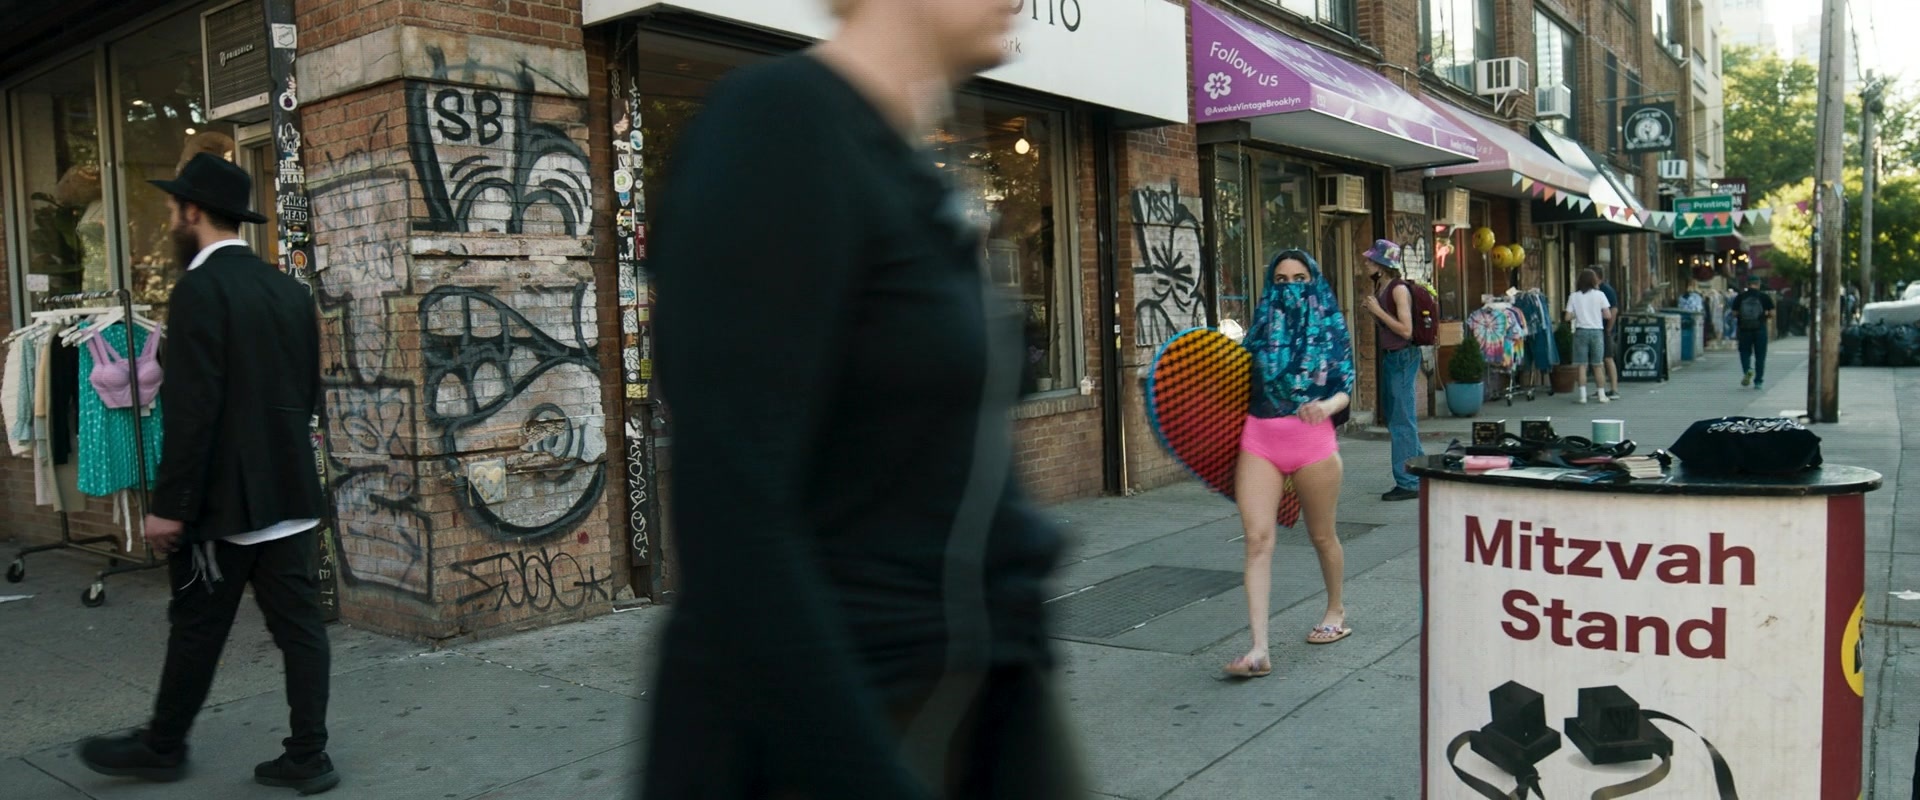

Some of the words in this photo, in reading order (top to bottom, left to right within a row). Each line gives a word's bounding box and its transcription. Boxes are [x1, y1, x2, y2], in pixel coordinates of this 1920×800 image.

[1002, 37, 1021, 53] ork
[1210, 41, 1257, 78] Follow
[1258, 73, 1278, 87] us
[1204, 97, 1301, 116] @AwokeVintageBrooklyn
[434, 88, 503, 145] SB
[283, 195, 308, 207] SNKR
[1693, 200, 1730, 209] Printing
[283, 210, 308, 221] HEAD
[1465, 514, 1755, 585] Mitzvah
[1501, 589, 1727, 659] Stand
